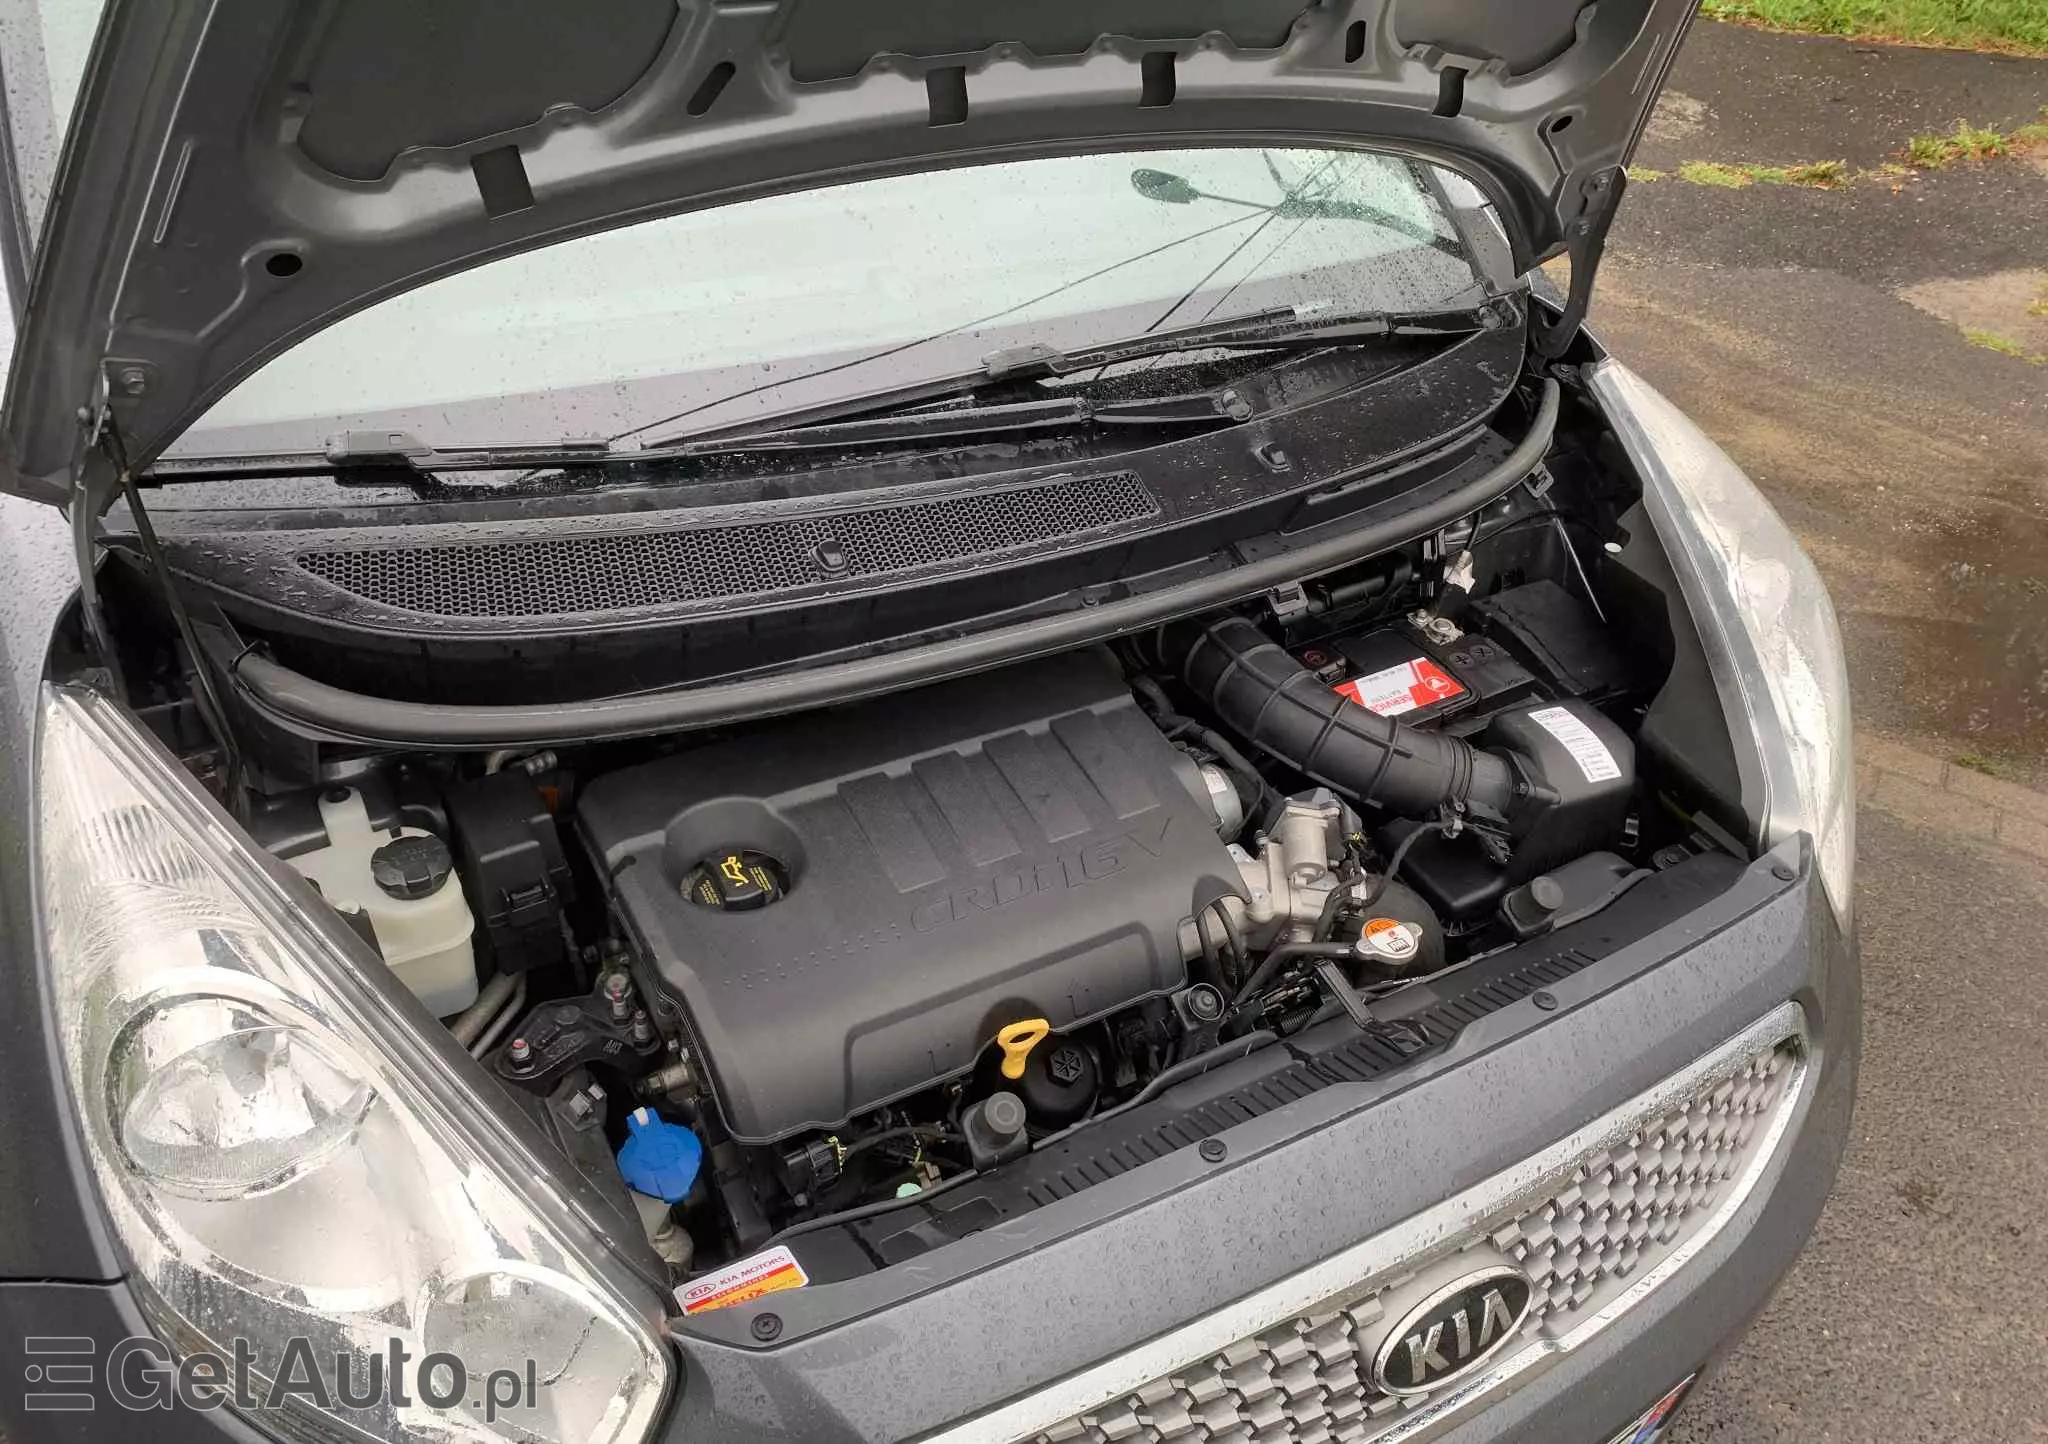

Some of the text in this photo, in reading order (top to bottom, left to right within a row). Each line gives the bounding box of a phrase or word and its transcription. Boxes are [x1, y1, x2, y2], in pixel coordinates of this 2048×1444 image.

[719, 1255, 785, 1285] KIA MOTORS
[690, 1285, 712, 1298] KIA
[1405, 1289, 1513, 1383] KIA
